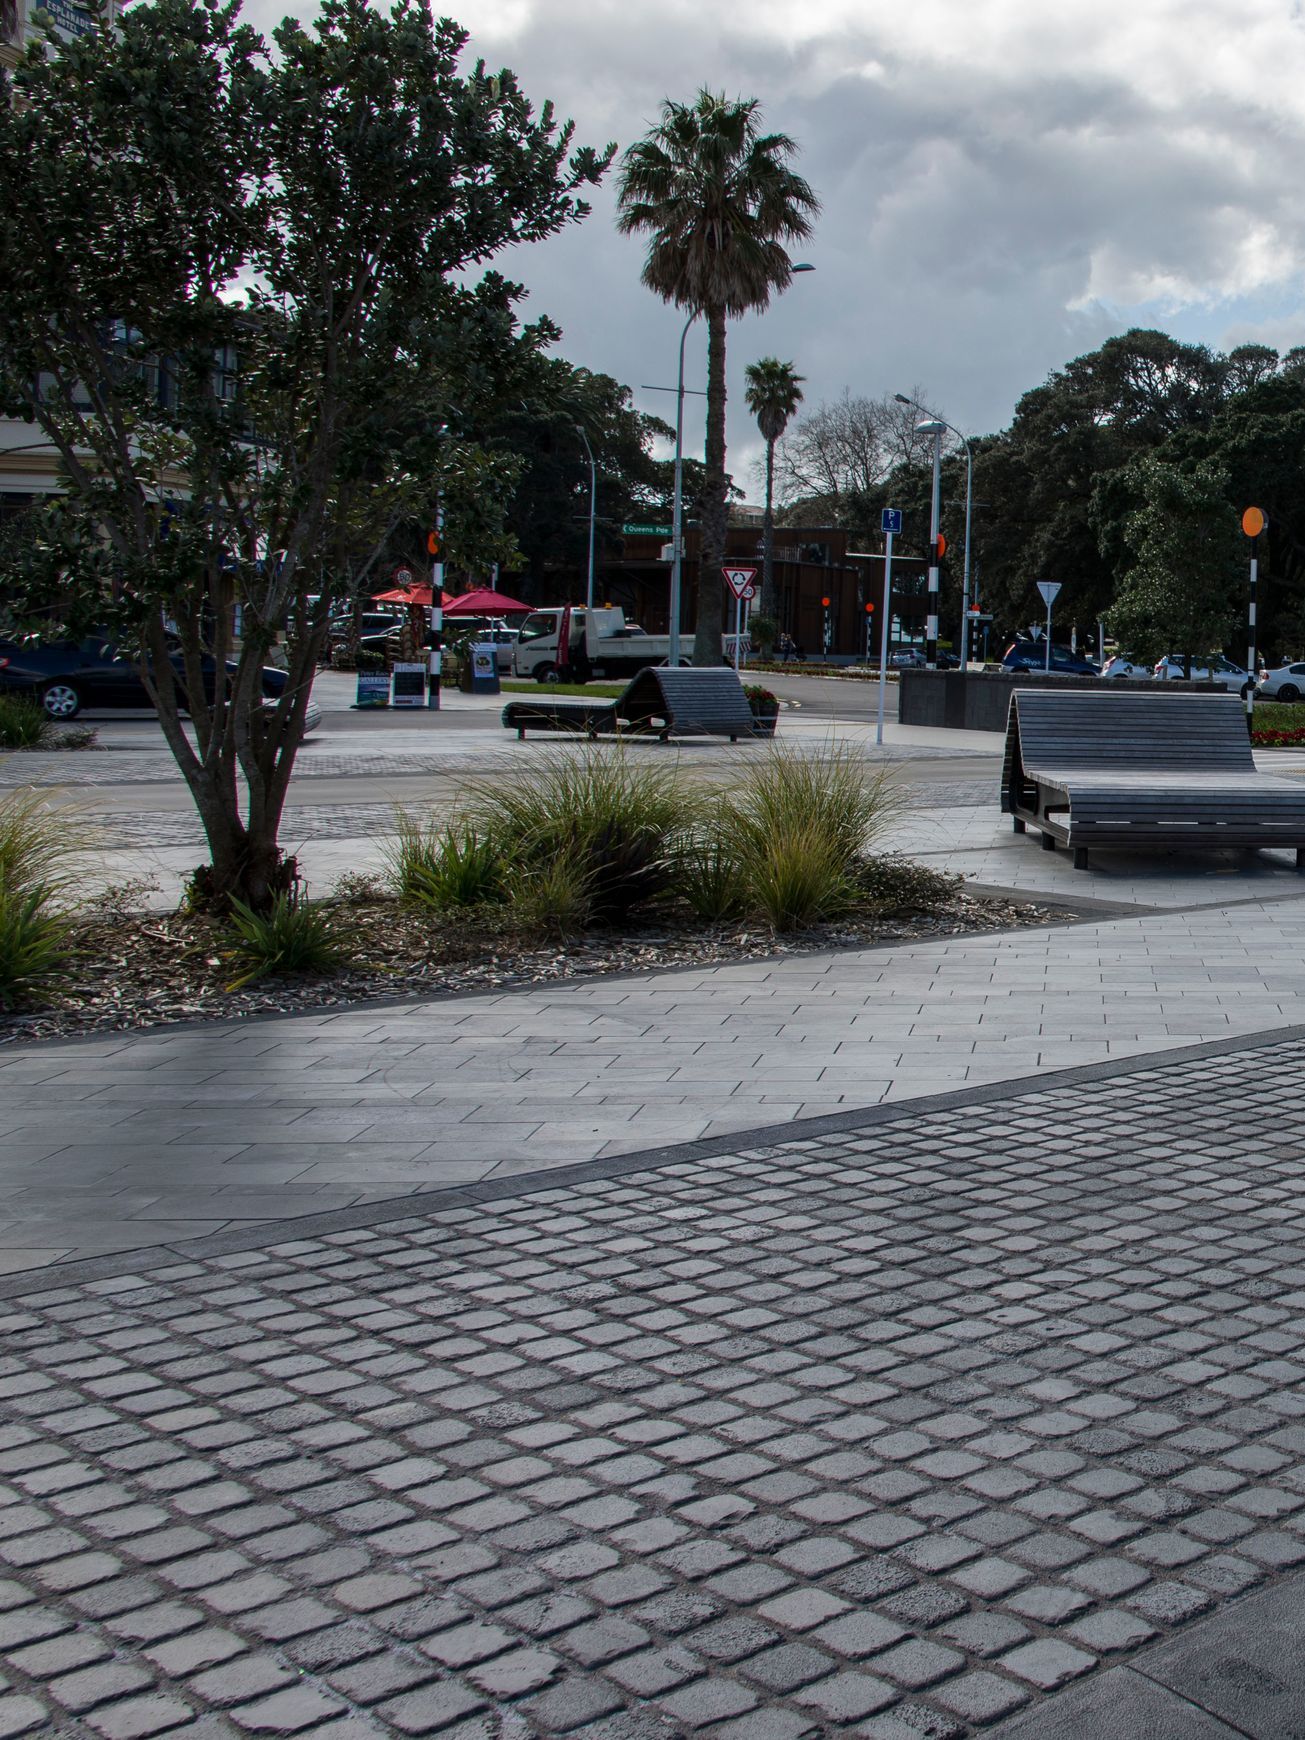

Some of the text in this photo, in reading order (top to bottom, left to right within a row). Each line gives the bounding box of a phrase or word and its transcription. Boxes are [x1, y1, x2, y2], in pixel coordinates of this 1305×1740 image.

[62, 1, 73, 11] THE
[46, 1, 90, 30] ESPLANADE
[56, 15, 78, 34] HOTEL
[888, 511, 895, 520] P
[656, 526, 669, 534] Pde
